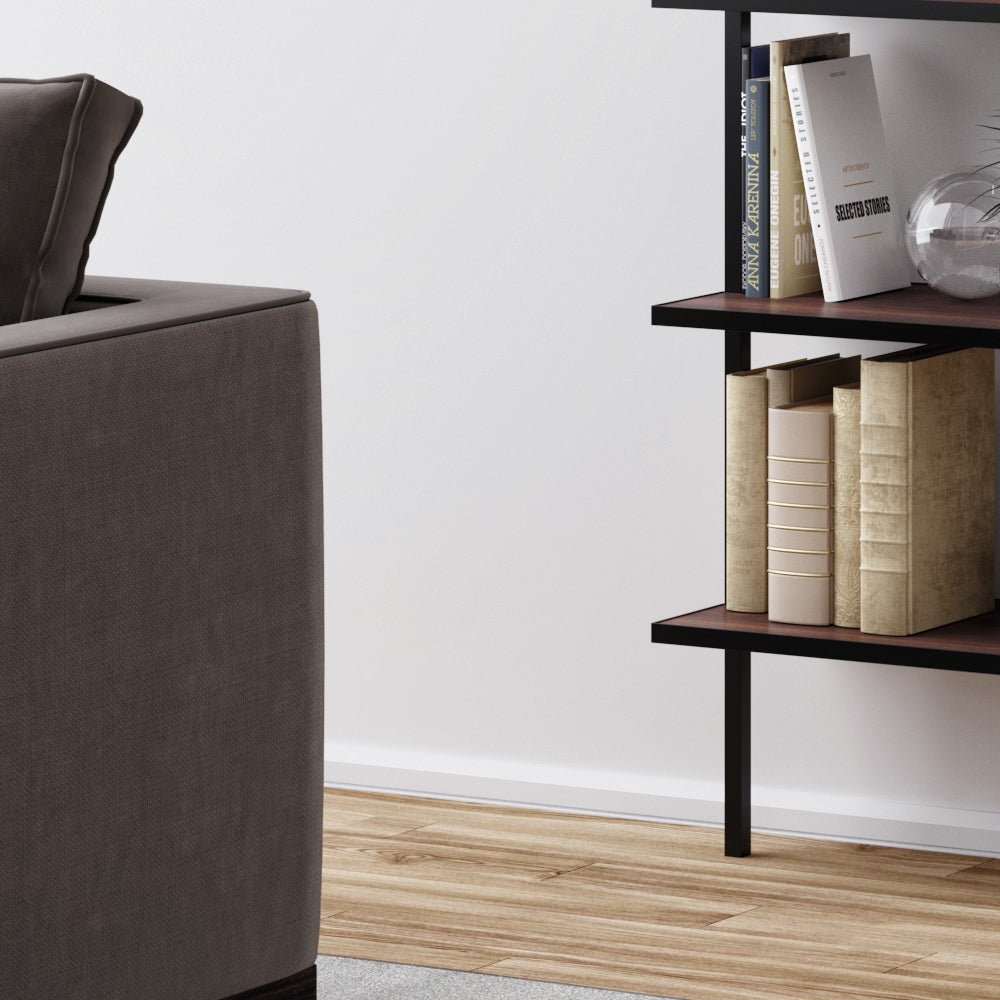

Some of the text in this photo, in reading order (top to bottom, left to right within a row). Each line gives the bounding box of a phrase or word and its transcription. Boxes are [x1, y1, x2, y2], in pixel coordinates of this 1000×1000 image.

[792, 87, 820, 215] SELECTED STORIES
[835, 196, 891, 221] SELECTED STORIES
[747, 152, 760, 292] ANNA KARENINA
[770, 170, 779, 289] EUGENE ONEGIN
